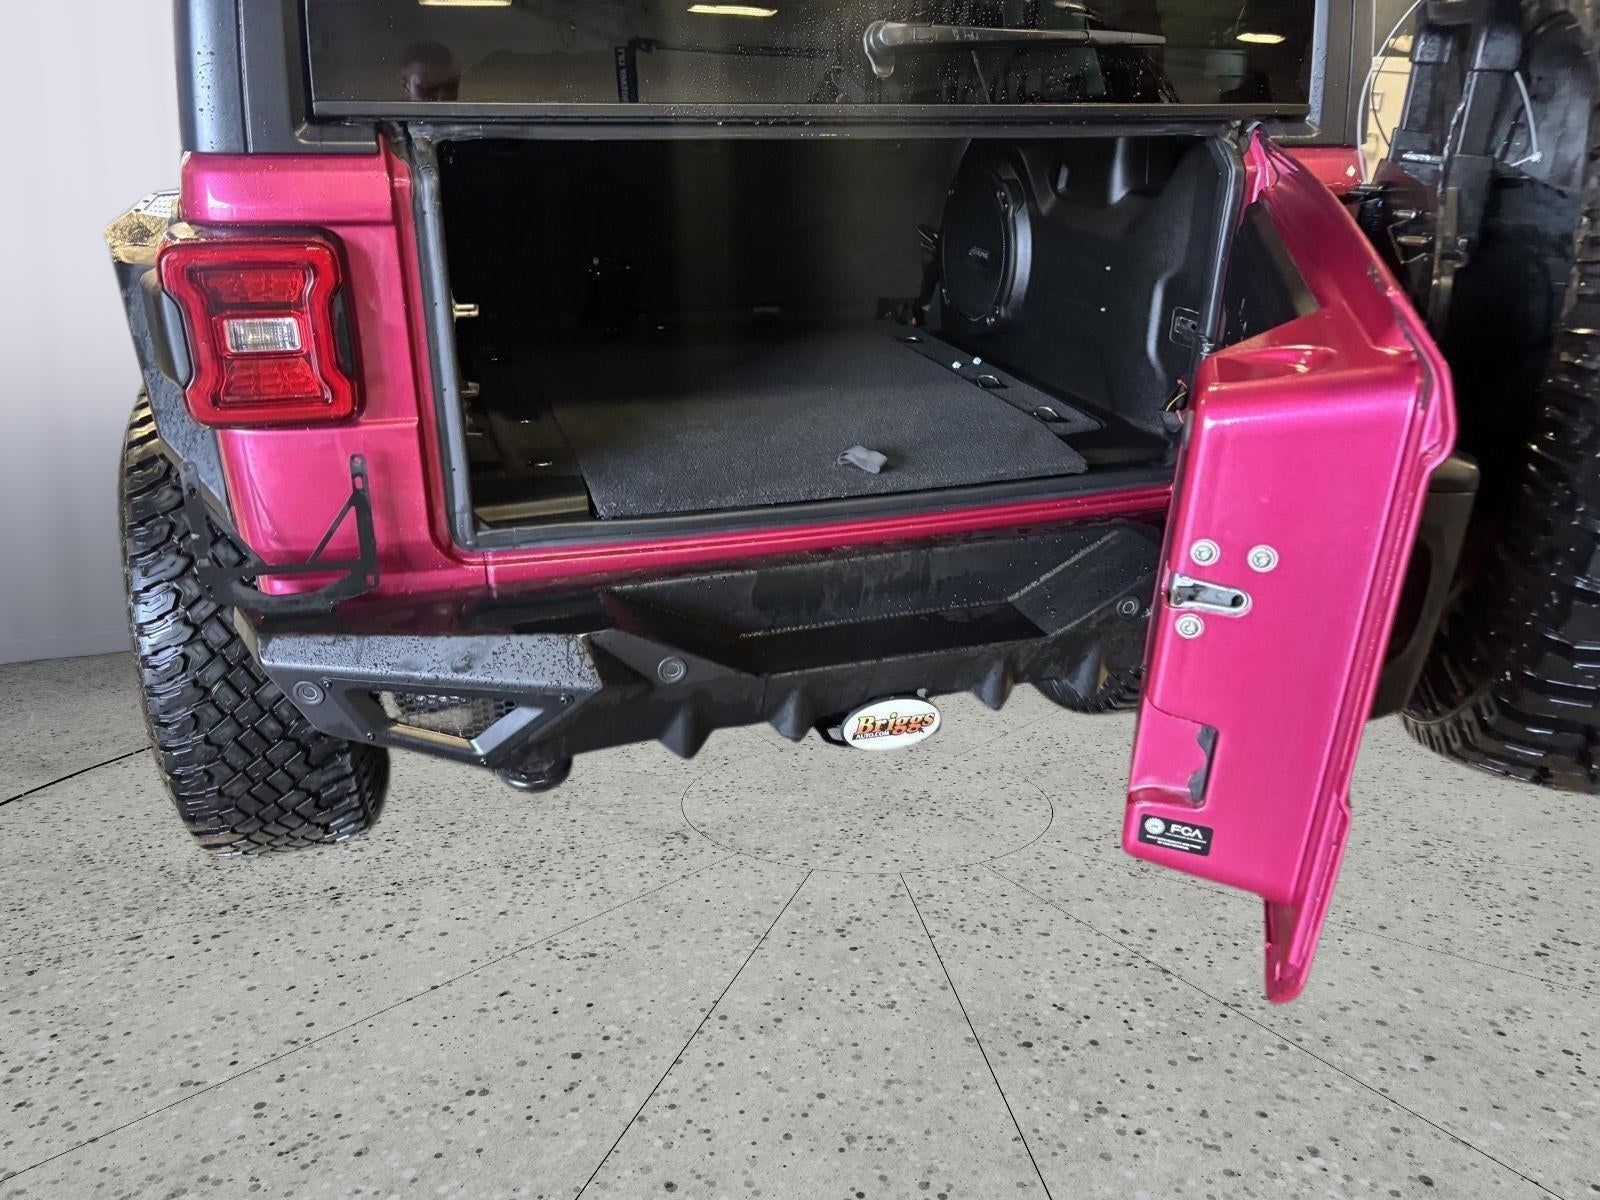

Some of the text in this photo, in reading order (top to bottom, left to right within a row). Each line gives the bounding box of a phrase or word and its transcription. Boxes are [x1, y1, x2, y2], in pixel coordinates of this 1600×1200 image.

[857, 712, 935, 736] Briggs
[855, 730, 891, 740] AUTO.COM
[1170, 823, 1203, 840] FCA
